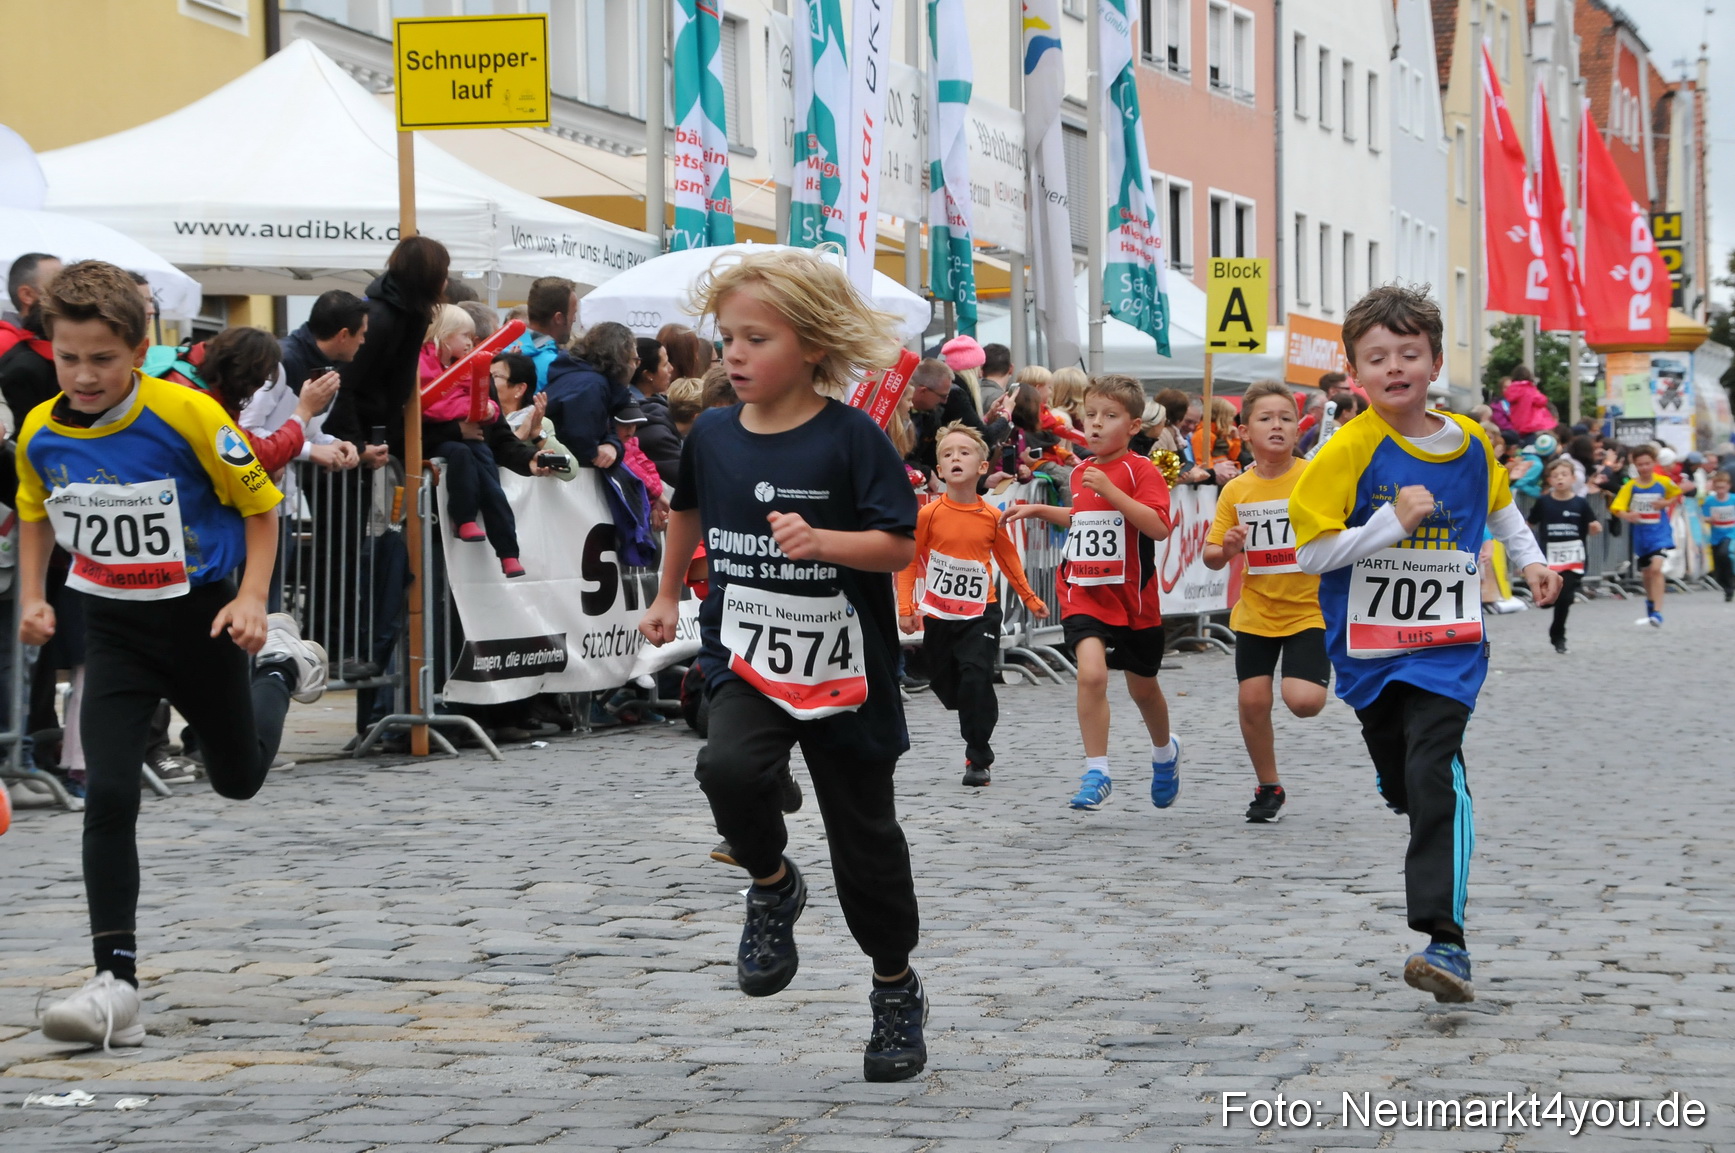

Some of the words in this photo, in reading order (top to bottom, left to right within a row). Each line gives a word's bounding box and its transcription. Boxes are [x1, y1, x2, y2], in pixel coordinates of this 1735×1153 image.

[406, 49, 537, 73] Schnupper-
[452, 78, 493, 100] lauf
[174, 220, 420, 241] www.audibkk.d
[511, 225, 534, 250] Von
[536, 236, 558, 258] uns,
[561, 234, 577, 259] für
[580, 242, 601, 263] uns:
[603, 244, 625, 270] Audi
[1213, 262, 1262, 279] Block
[1218, 287, 1254, 333] A
[89, 495, 153, 508] Neumarkt
[1371, 493, 1392, 501] Jahre
[1238, 509, 1261, 518] PARTL
[62, 511, 170, 557] 7205
[1066, 529, 1117, 558] 7133
[1265, 551, 1295, 564] Robin
[1356, 558, 1399, 570] PARTL
[1402, 561, 1460, 573] Neumarkt
[933, 567, 983, 599] 7585
[1365, 576, 1465, 621] 7021
[727, 599, 772, 617] PARTL
[775, 607, 842, 624] Neumarkt
[1397, 631, 1434, 643] Luis
[505, 651, 520, 668] die
[521, 648, 565, 666] verbinden
[738, 621, 852, 677] 7574
